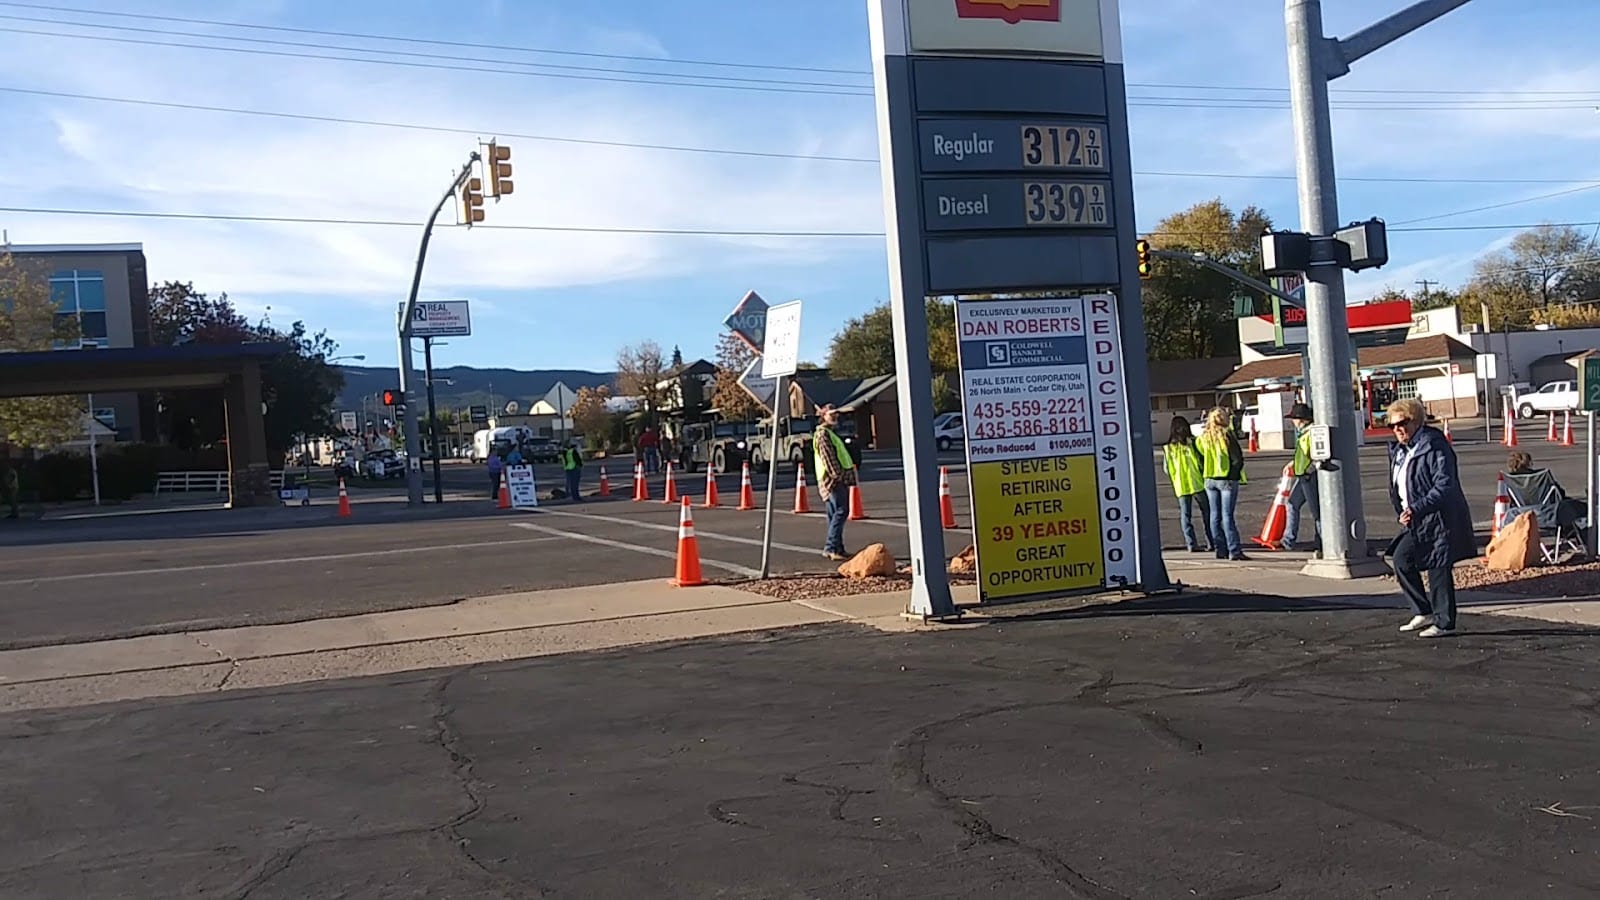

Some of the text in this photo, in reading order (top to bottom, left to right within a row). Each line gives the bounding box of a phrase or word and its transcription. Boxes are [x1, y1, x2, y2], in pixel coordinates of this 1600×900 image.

[933, 132, 994, 161] Regular
[1023, 127, 1082, 165] 312
[938, 194, 989, 216] Diesel
[1027, 184, 1085, 222] 339
[970, 308, 1018, 317] EXCLUSIVELY
[1021, 307, 1060, 315] MARKETED
[963, 317, 1081, 336] DAN ROBERTS
[1012, 355, 1063, 364] COMMERCIAL
[1091, 300, 1120, 436] REDUCED
[969, 388, 979, 396] 26
[981, 386, 1001, 395] North
[1028, 384, 1049, 393] Cedar
[1068, 382, 1085, 390] Utah
[972, 373, 1081, 386] REAL ESTATE CORPORATION
[973, 397, 1085, 419] 435-559-2221
[975, 416, 1087, 438] 435-586-8181
[971, 445, 994, 455] Price
[996, 441, 1036, 453] Reduced
[1001, 457, 1068, 476] STEVE IS
[1001, 478, 1072, 496] RETIRING
[1014, 499, 1063, 516] AFTER
[992, 519, 1087, 542] 39 YEARS!
[1016, 544, 1067, 562] GREAT
[989, 561, 1096, 586] OPPORTUNITY
